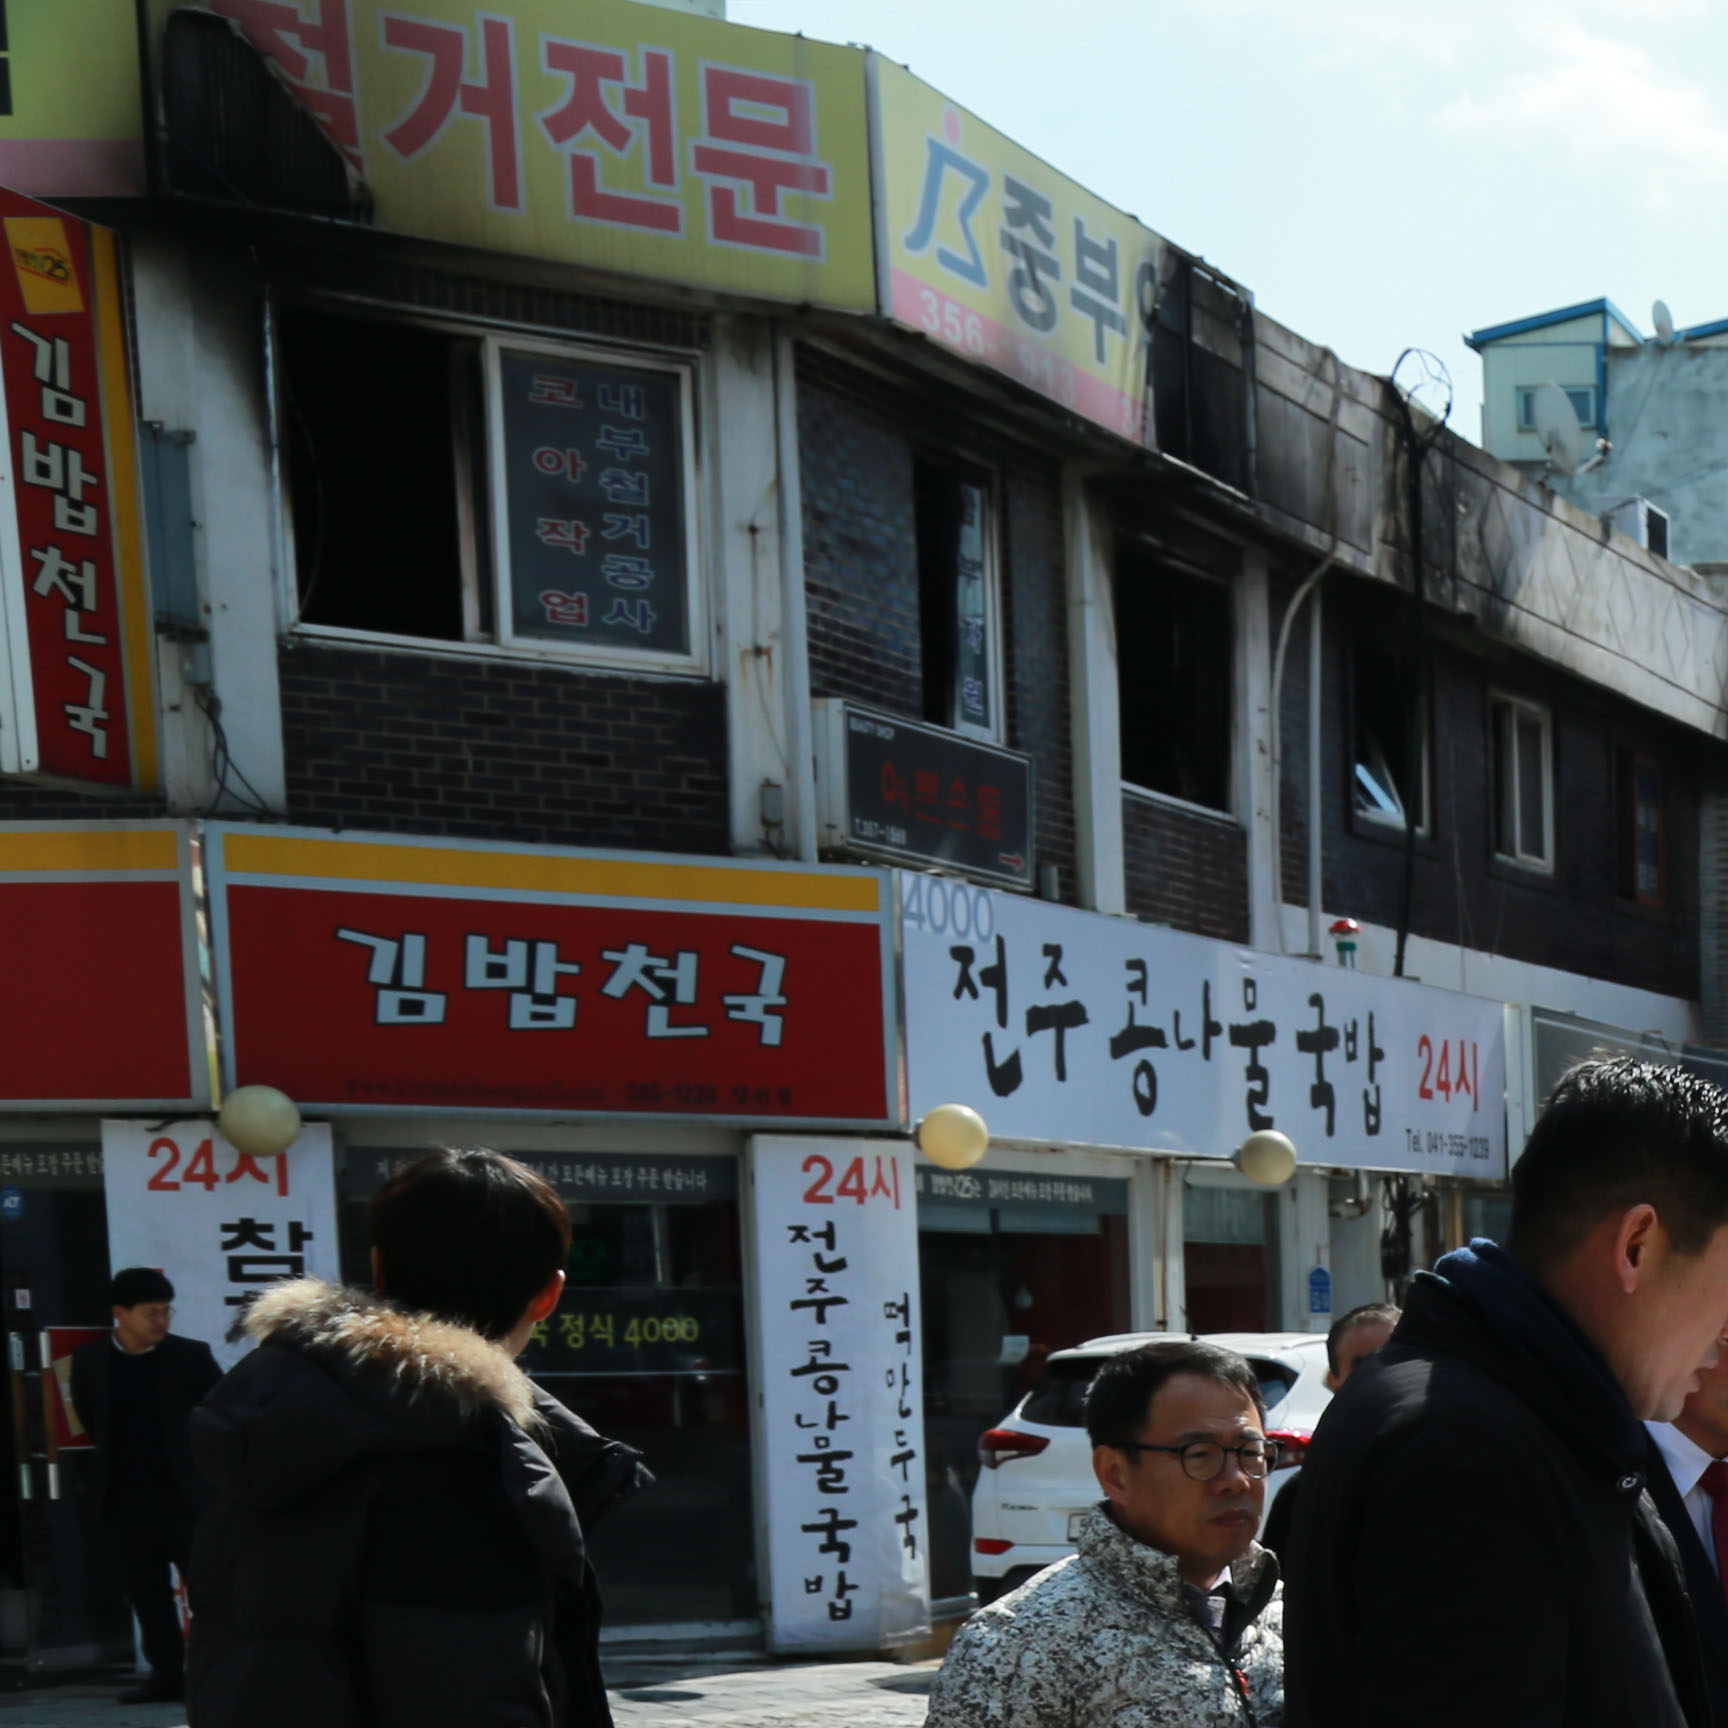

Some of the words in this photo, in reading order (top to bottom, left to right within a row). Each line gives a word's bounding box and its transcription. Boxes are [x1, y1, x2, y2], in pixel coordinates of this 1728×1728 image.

[10, 319, 111, 761] 김밥천국
[528, 375, 590, 627] 코아작업
[595, 380, 657, 637] 내부철거공사
[336, 927, 790, 1047] 김밥천국
[948, 934, 1386, 1138] 전주콩나물국밥
[1416, 1032, 1480, 1113] 24시
[801, 1154, 901, 1211] 24시
[559, 1312, 615, 1350] 정식
[623, 1315, 700, 1349] 4000
